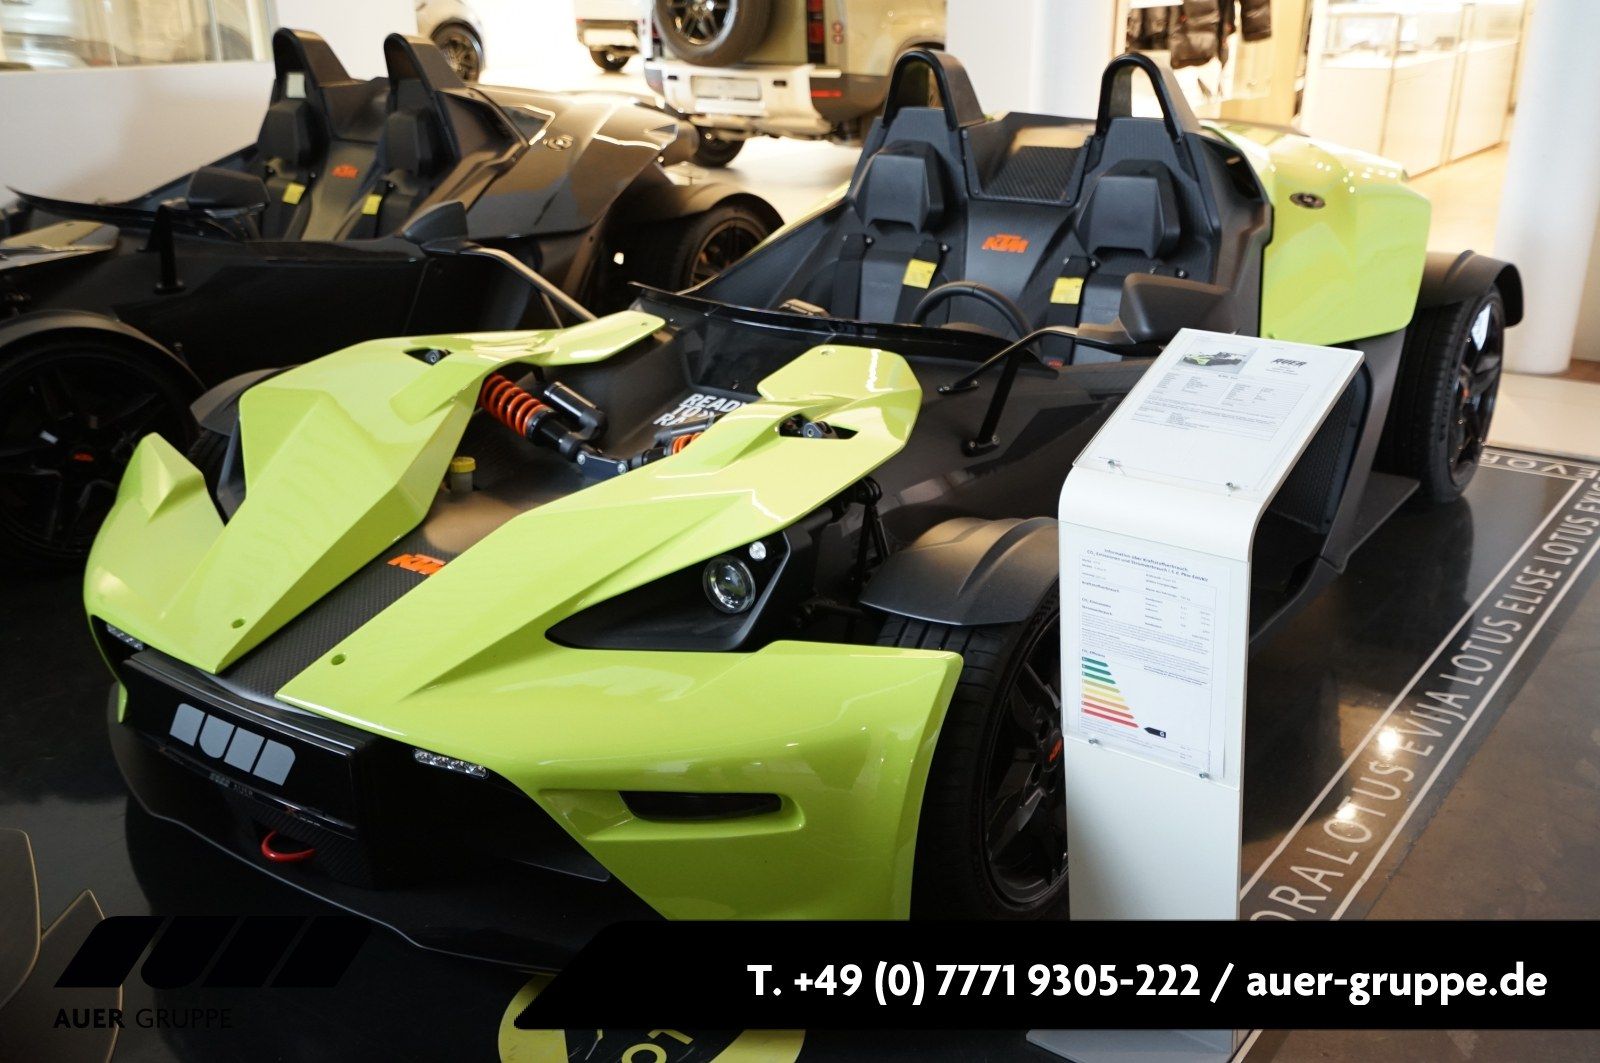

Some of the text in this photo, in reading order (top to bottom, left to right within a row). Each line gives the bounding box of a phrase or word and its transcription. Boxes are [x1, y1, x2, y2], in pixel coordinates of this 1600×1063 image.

[981, 233, 1030, 253] KTM
[671, 403, 701, 417] TO
[679, 393, 747, 413] READ
[1306, 760, 1414, 865] LOTUS
[1393, 691, 1471, 757] EVIJA
[1439, 616, 1522, 686] LOTUS
[1495, 565, 1561, 615] ELISE
[1534, 514, 1599, 566] LOTUS
